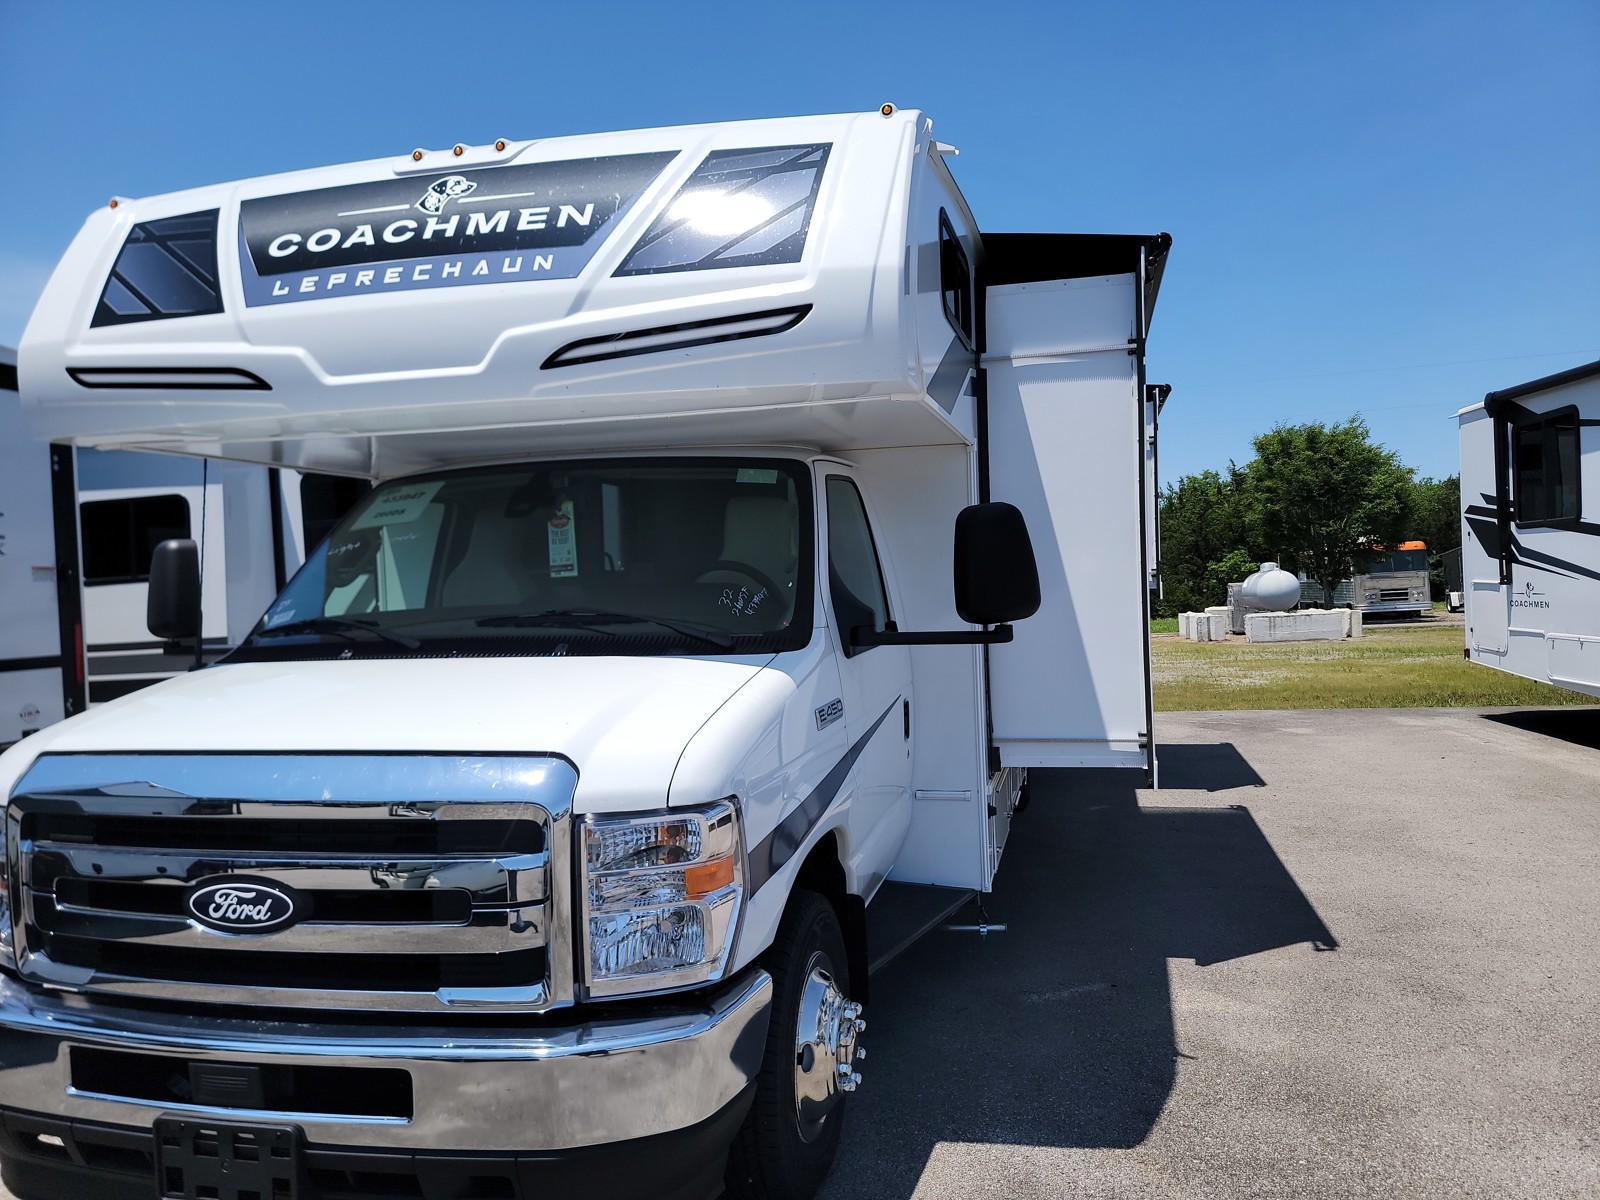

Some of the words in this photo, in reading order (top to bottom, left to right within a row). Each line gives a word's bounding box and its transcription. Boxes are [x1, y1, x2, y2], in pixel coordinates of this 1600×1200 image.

[268, 203, 595, 258] COACHMEN
[271, 254, 554, 296] LEPRECHAUN
[718, 588, 734, 607] 32
[1509, 599, 1550, 609] COACHMEN
[208, 889, 273, 921] Ford
